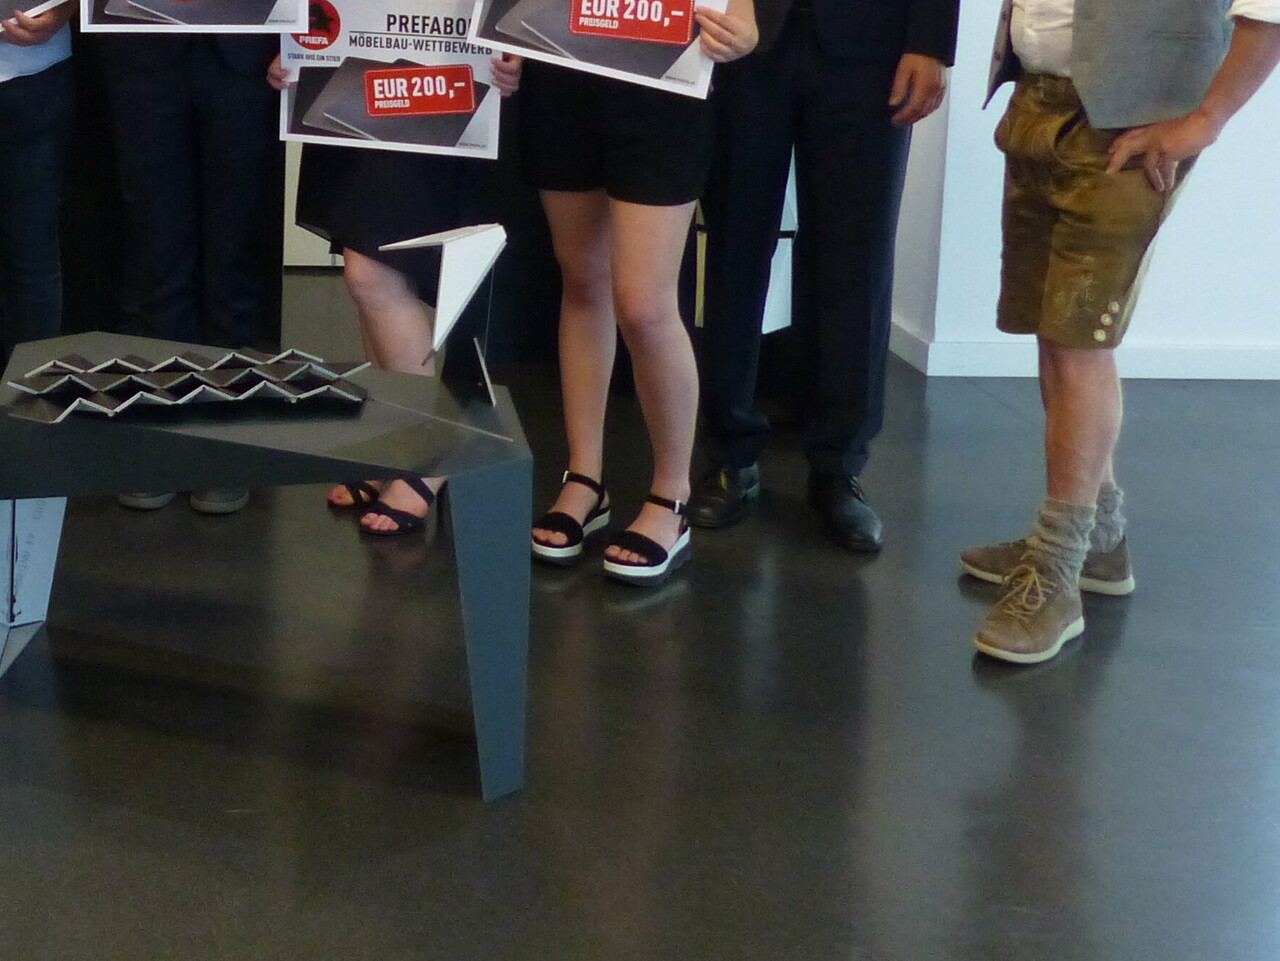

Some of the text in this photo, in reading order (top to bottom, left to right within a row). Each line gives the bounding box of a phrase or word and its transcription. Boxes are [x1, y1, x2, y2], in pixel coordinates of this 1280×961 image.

[579, 17, 619, 29] PREISGELD
[299, 35, 329, 45] PREFA
[373, 77, 409, 99] EUR
[374, 99, 411, 110] PREISGELD
